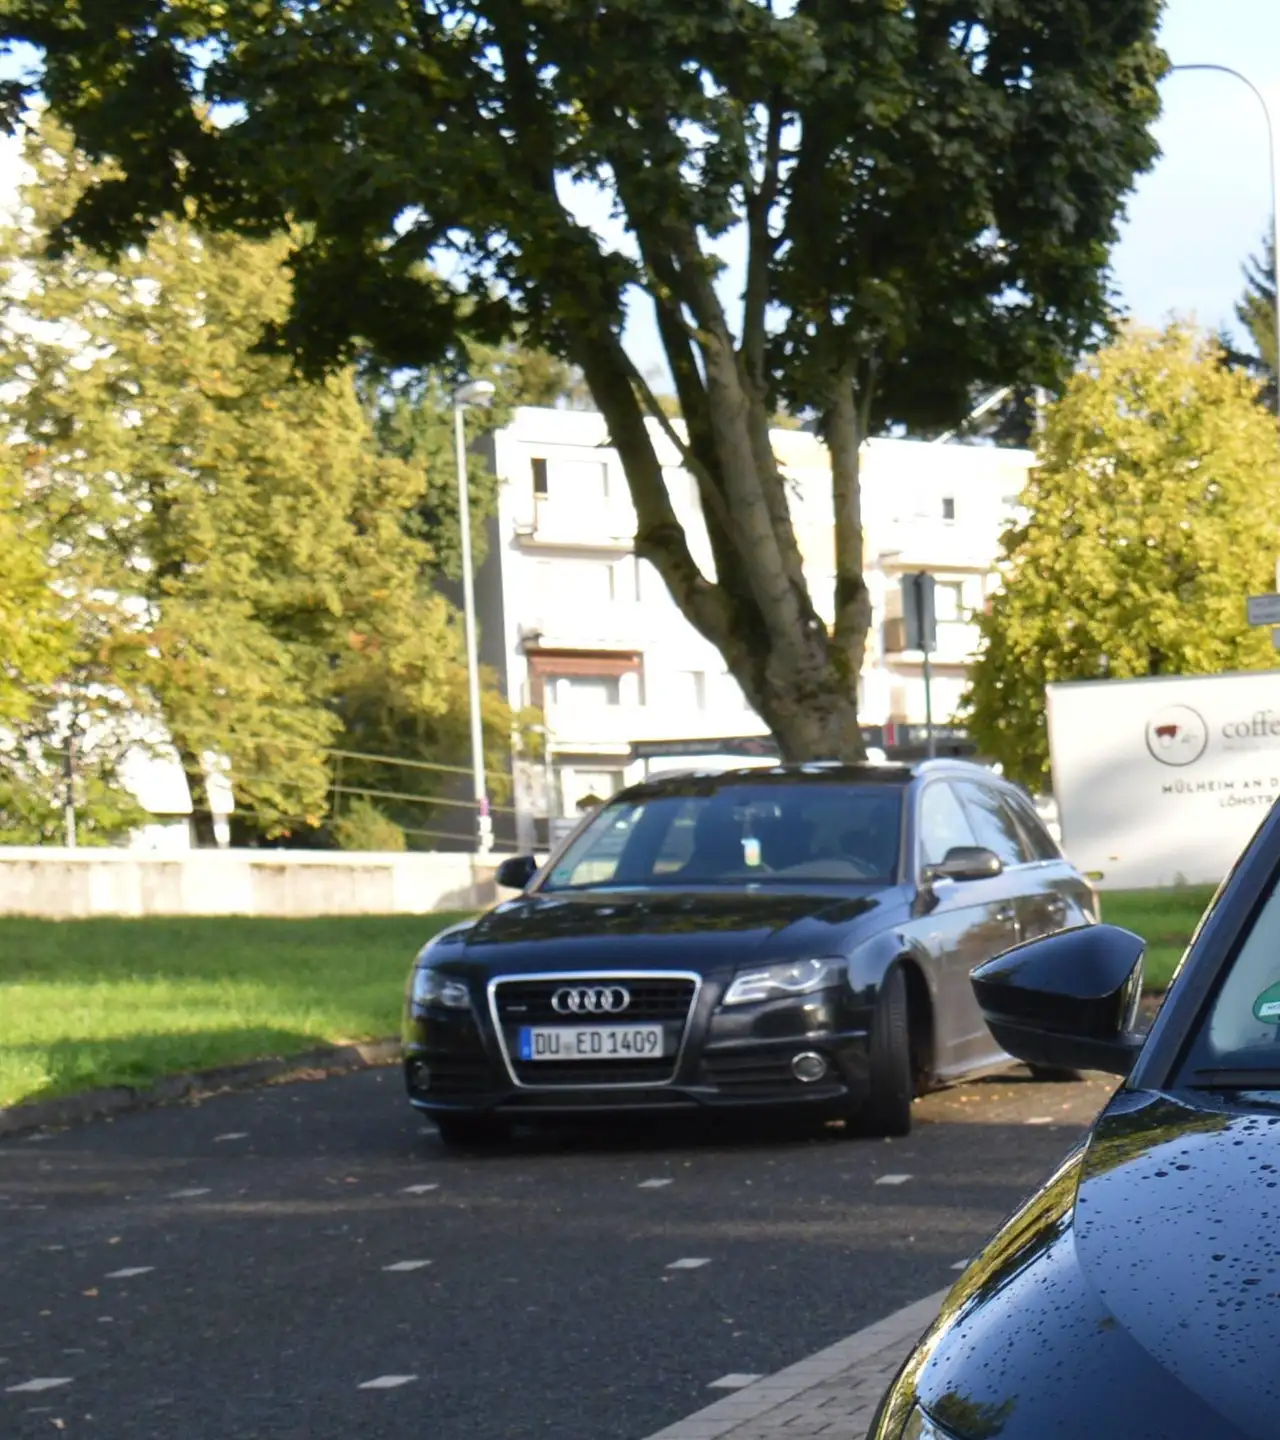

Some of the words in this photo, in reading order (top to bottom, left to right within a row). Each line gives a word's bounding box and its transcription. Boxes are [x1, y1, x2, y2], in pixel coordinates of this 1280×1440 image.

[1161, 779, 1234, 794] MÜLHEIM
[1243, 780, 1262, 789] AN
[534, 1032, 560, 1055] DU
[576, 1031, 602, 1054] ED
[607, 1030, 658, 1053] 1409
